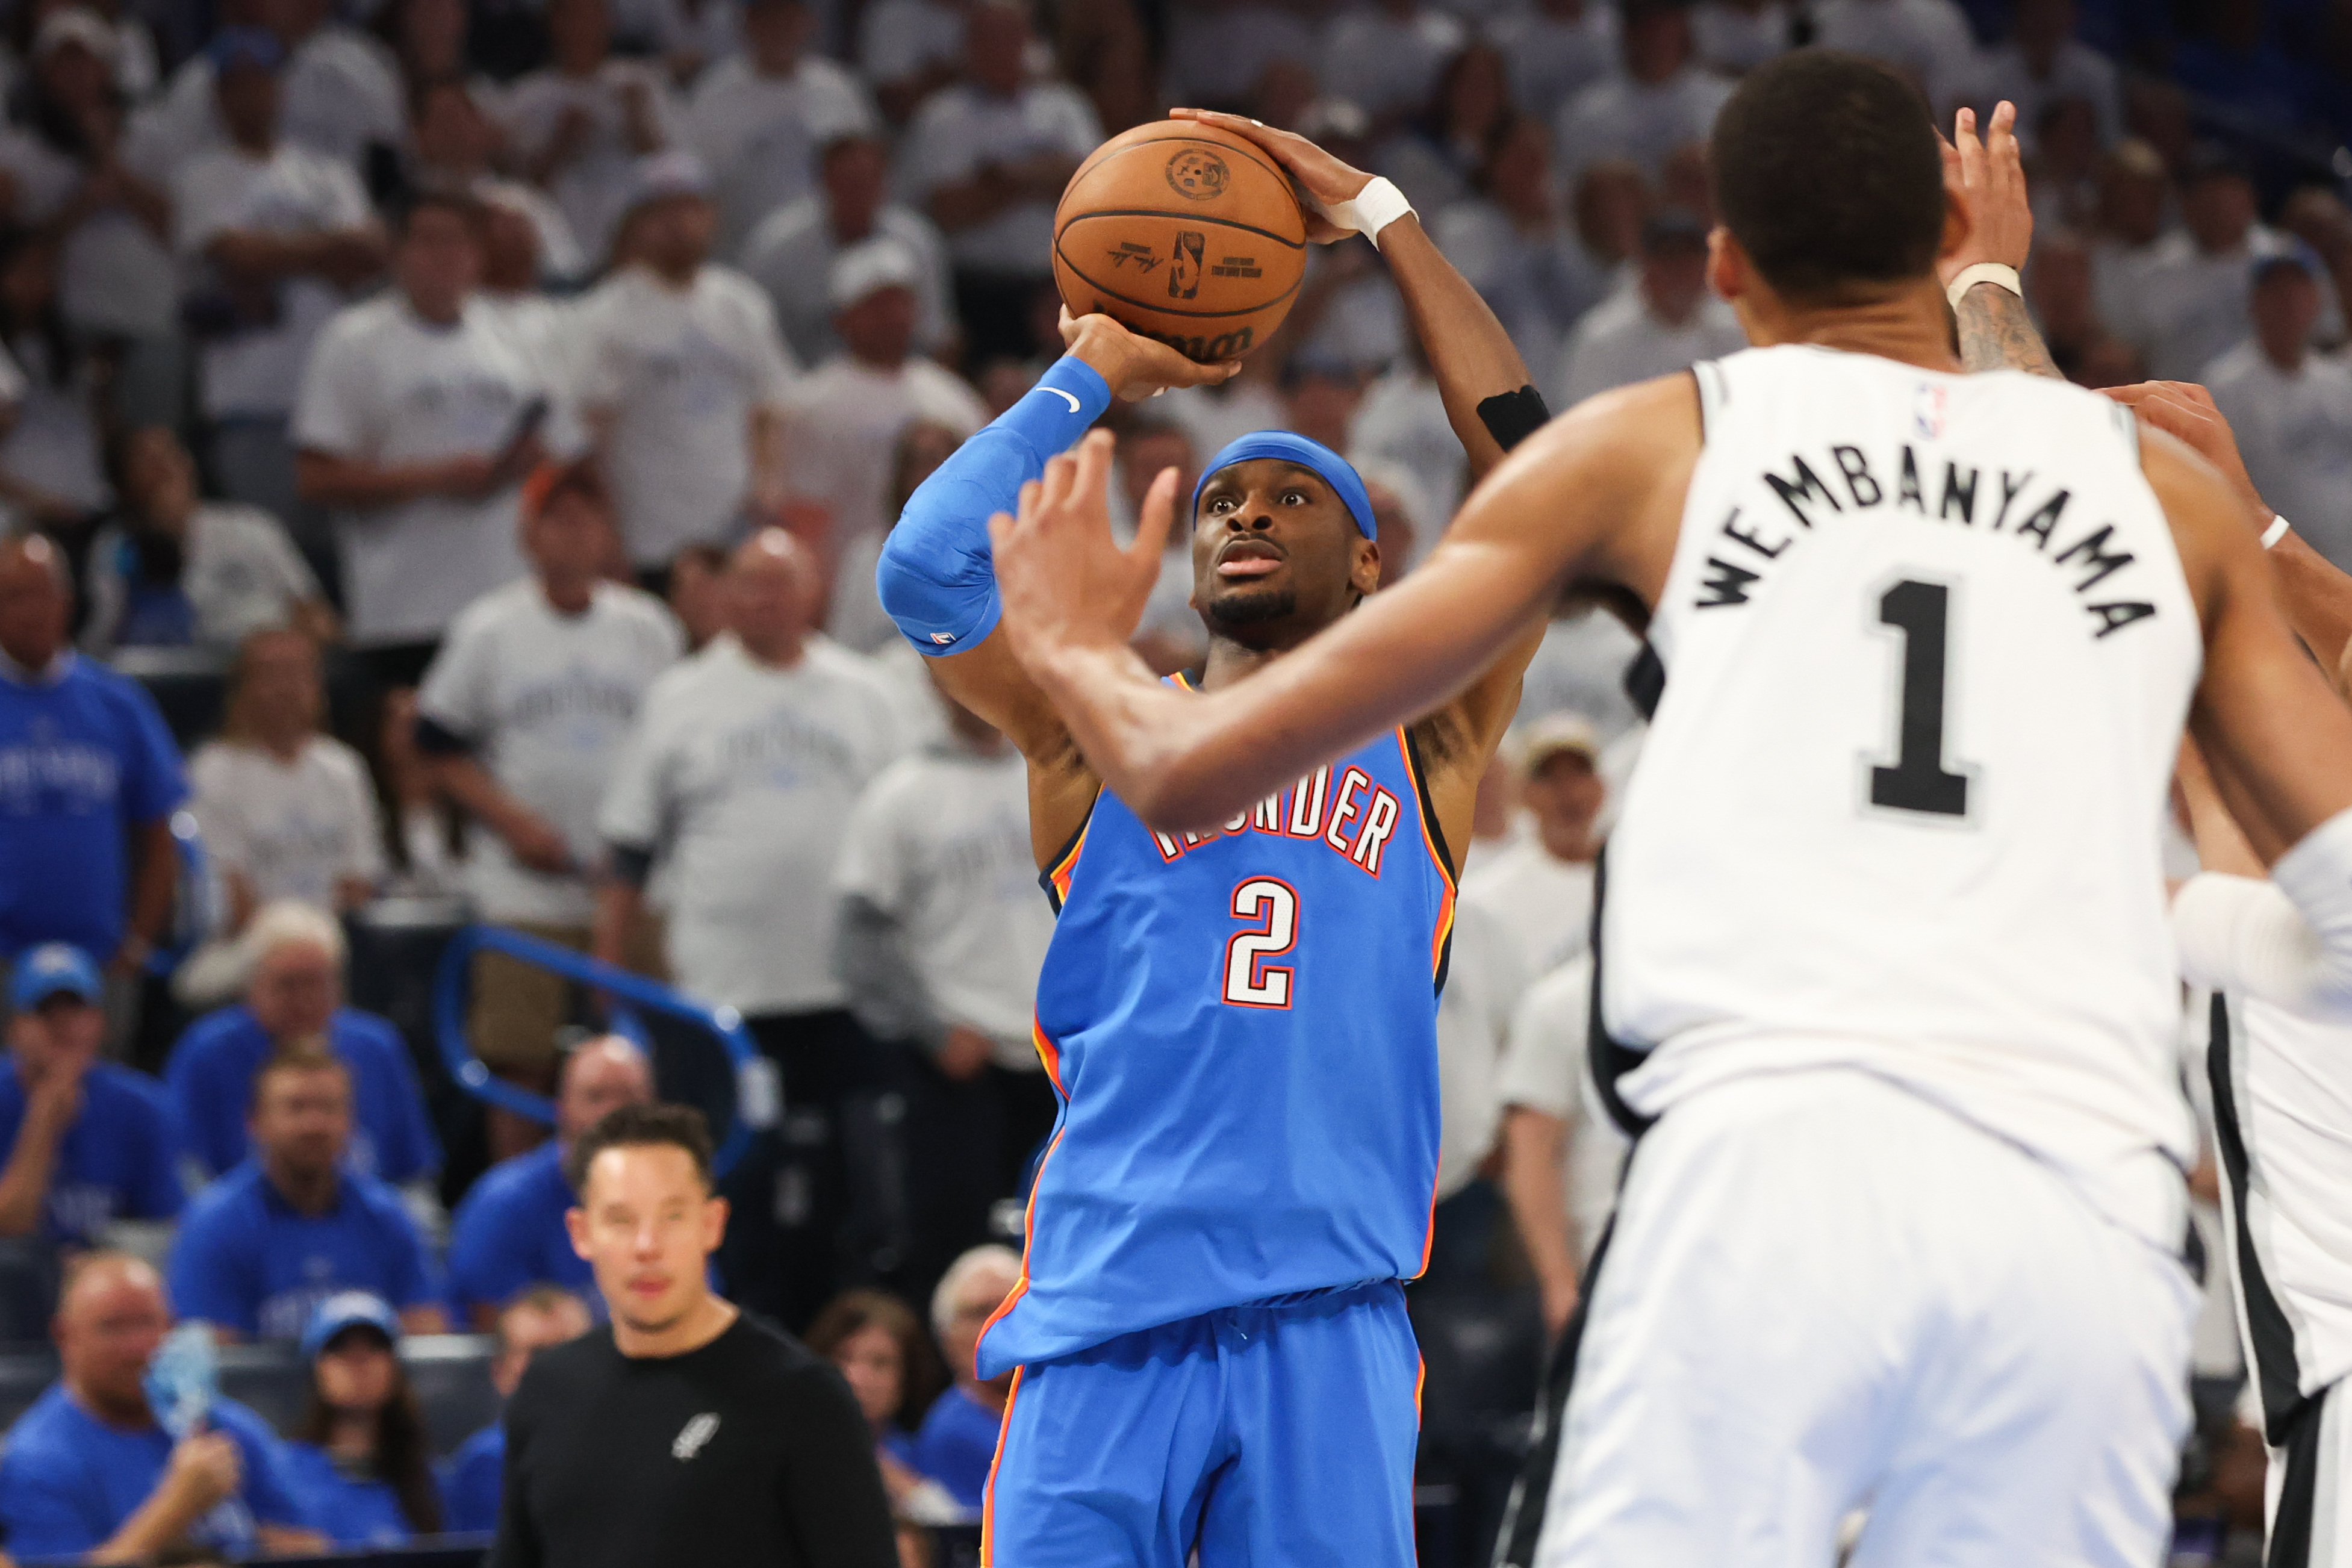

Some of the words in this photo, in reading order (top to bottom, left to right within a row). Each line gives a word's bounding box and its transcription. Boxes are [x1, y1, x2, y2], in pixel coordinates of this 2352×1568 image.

[1693, 444, 2158, 640] WEMBANYAMA
[1864, 573, 1973, 820] 1
[1221, 875, 1300, 1010] 2
